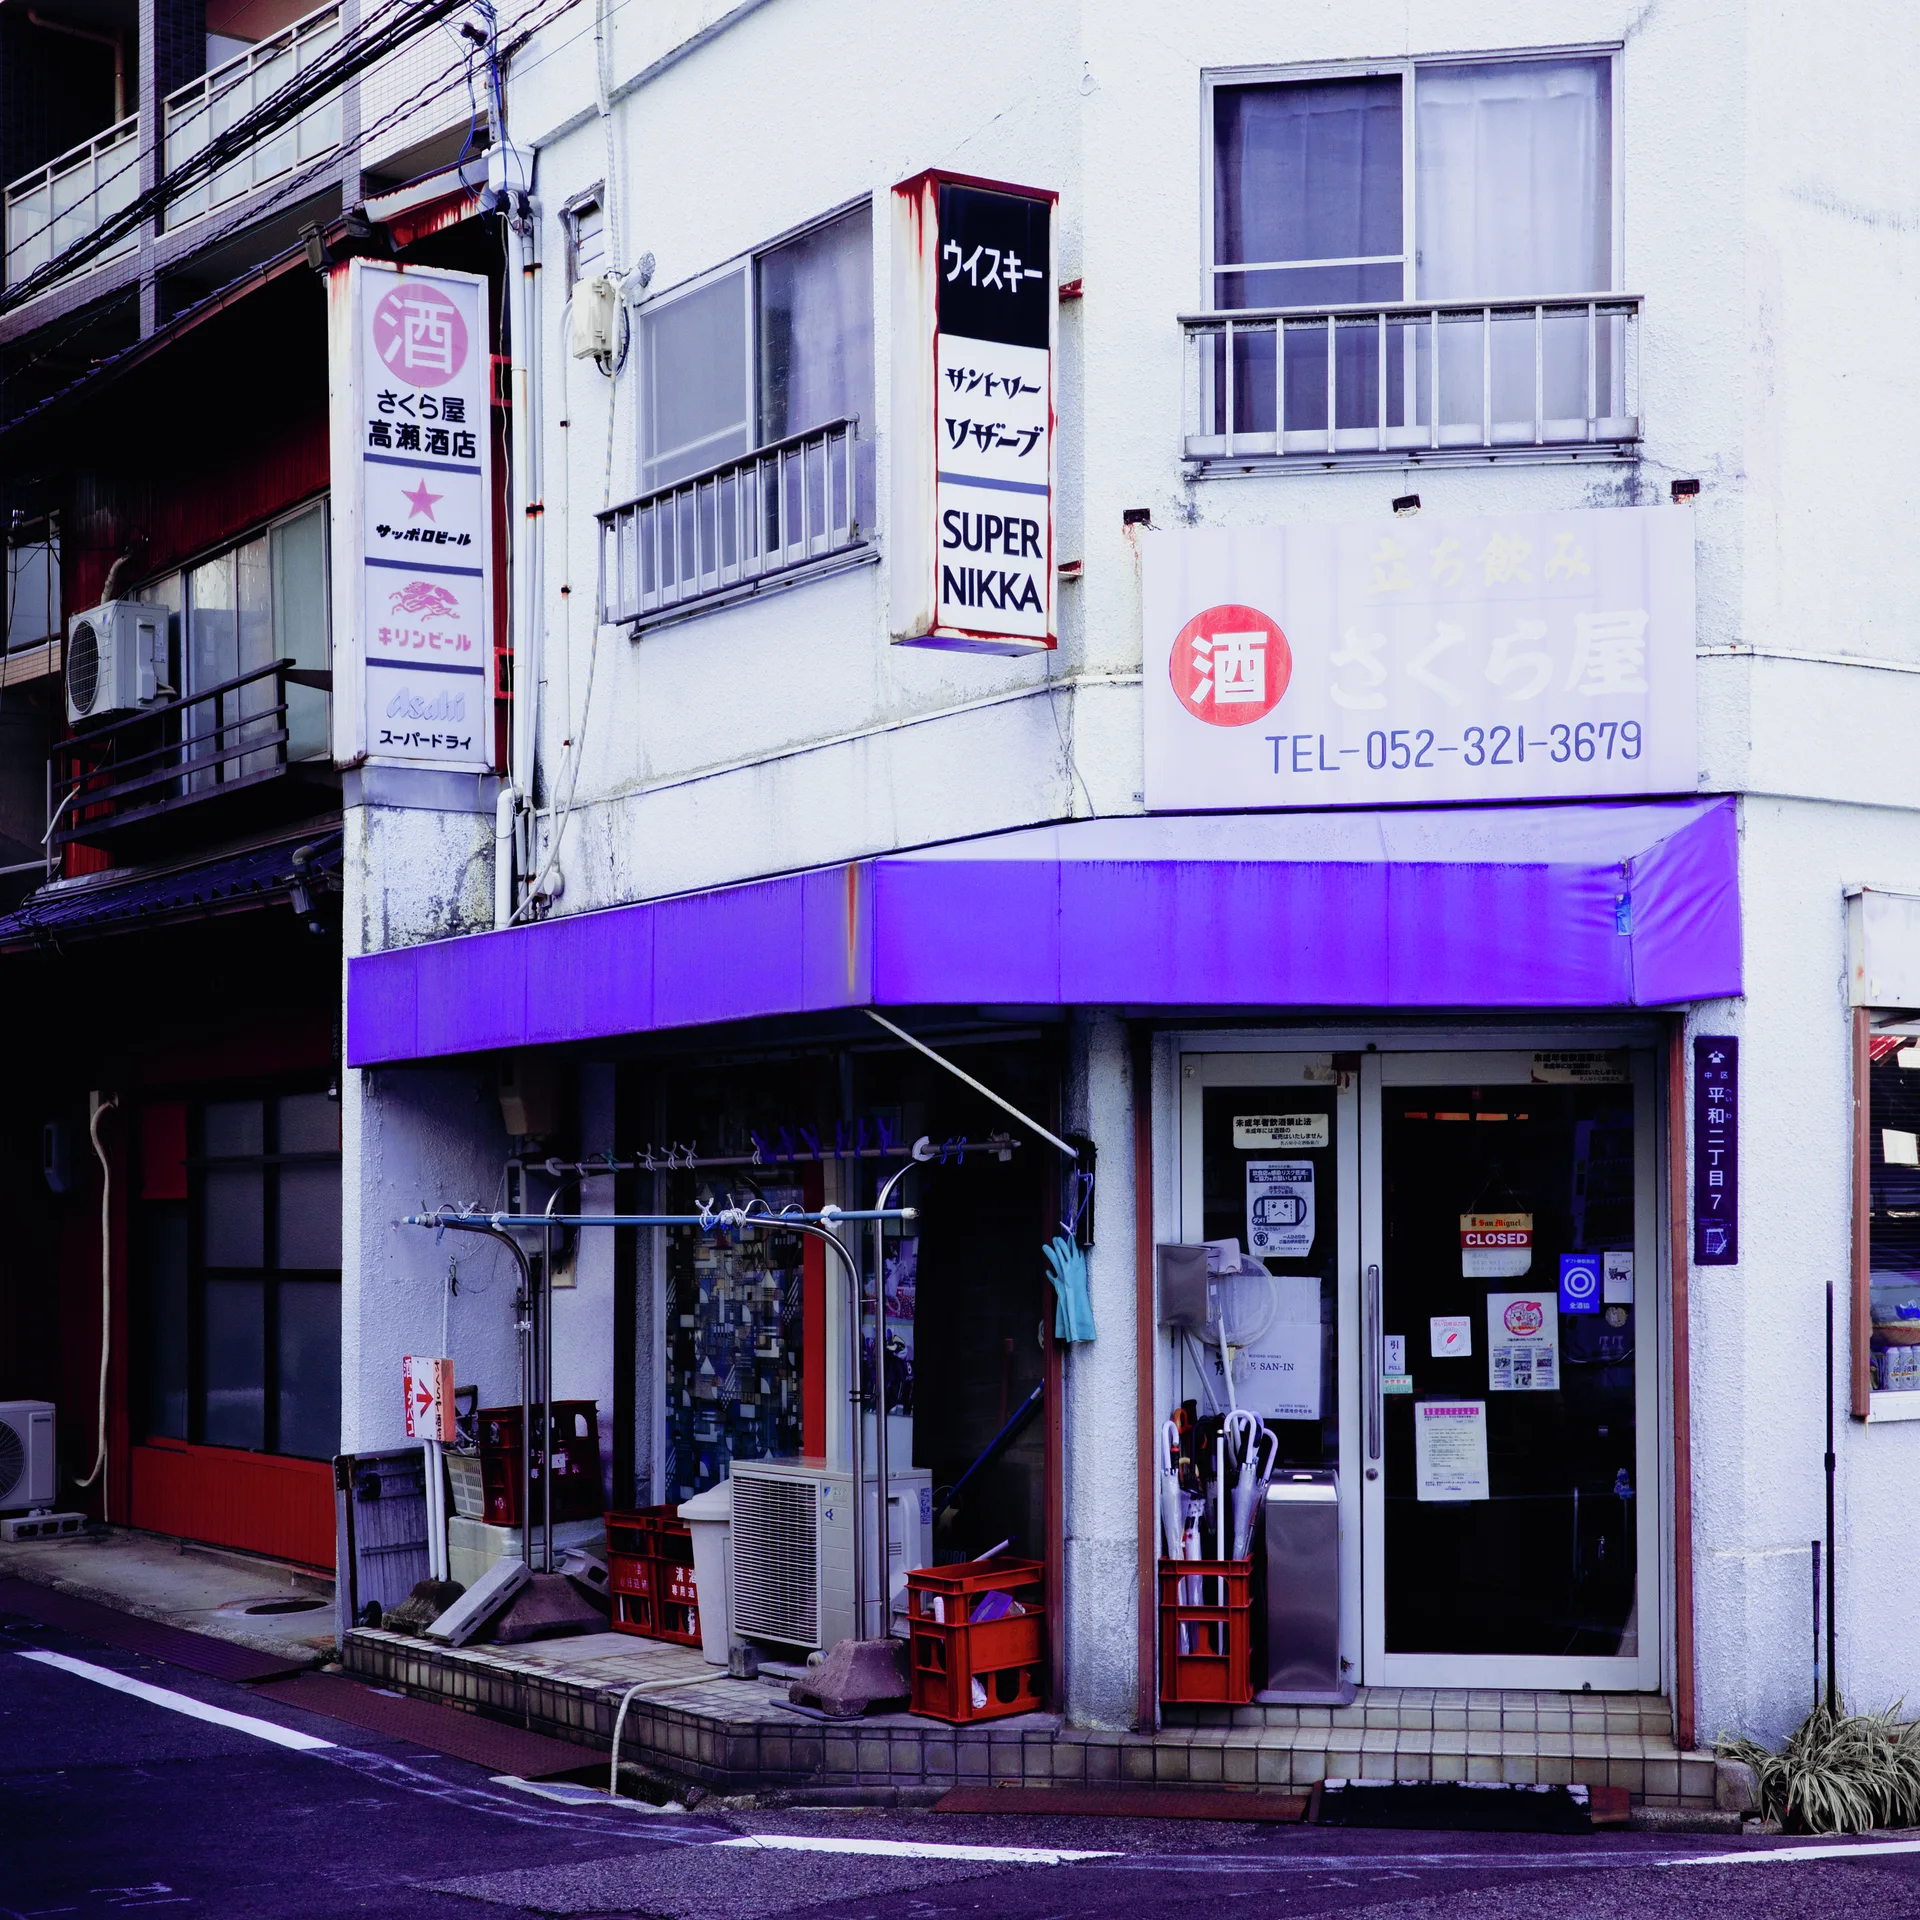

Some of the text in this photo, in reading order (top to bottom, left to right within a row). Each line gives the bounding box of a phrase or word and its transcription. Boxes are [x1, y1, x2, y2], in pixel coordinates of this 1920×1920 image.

[944, 239, 1043, 293] ウイスキー
[381, 294, 454, 374] 酒
[945, 367, 1041, 399] サントリー
[377, 389, 466, 423] さくら屋
[368, 419, 476, 459] 高瀬酒店
[945, 418, 1044, 457] リザーブ
[376, 524, 471, 546] サッポロビール
[943, 509, 1043, 559] SUPER
[1365, 533, 1590, 595] 立ち飲み
[943, 565, 1043, 613] NIKKA
[378, 627, 471, 652] キリンビール
[1190, 631, 1267, 704] 酒
[1329, 608, 1650, 710] さくら屋
[386, 686, 465, 722] Asahi
[379, 730, 471, 750] スーパードライ
[1704, 1071, 1728, 1079] 中区
[1235, 1118, 1312, 1127] 未成年者飲酒禁止法
[1707, 1087, 1724, 1210] 平和二丁目7
[1465, 1233, 1528, 1245] CLOSED
[1260, 1362, 1294, 1371] SAN-IN
[1390, 1340, 1399, 1361] 引く
